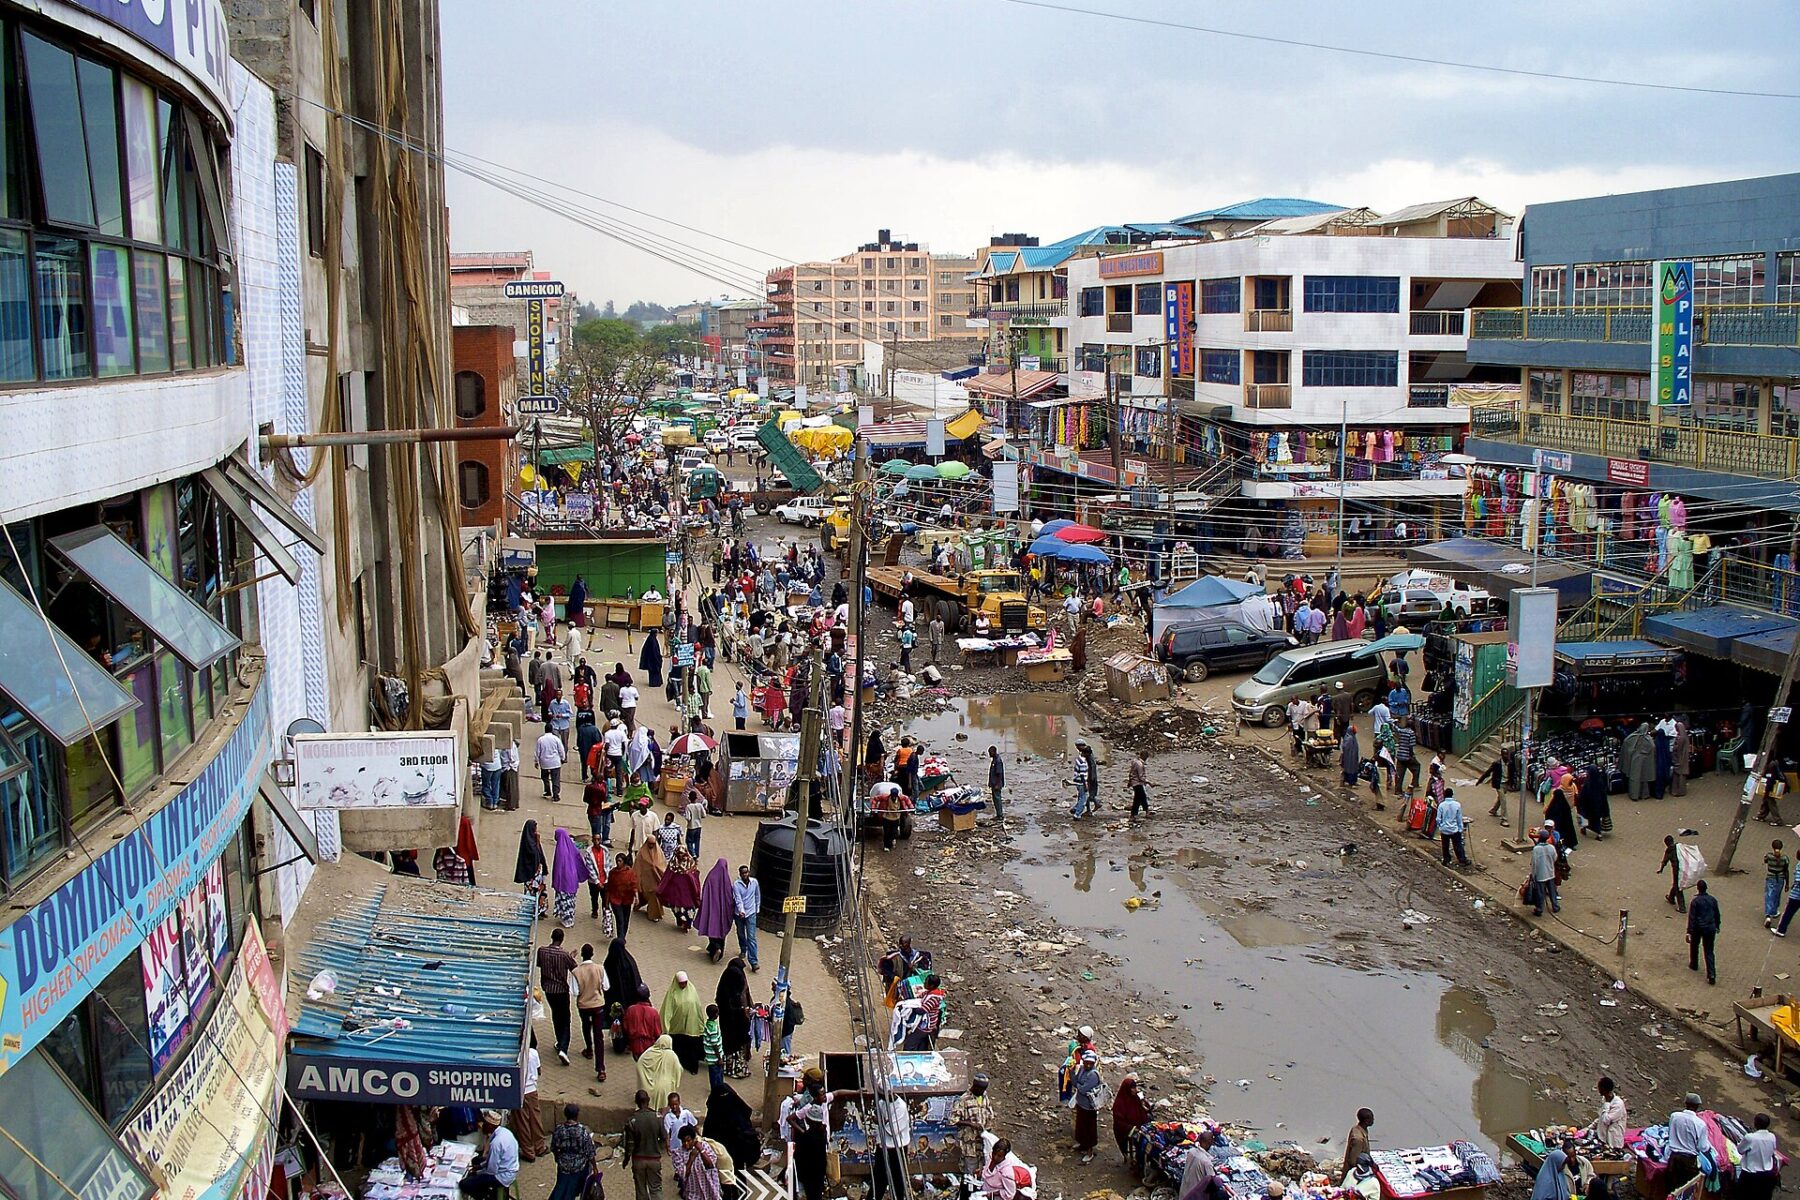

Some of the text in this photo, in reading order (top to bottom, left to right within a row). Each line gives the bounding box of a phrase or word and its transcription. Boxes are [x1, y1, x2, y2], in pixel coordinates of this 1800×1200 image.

[506, 284, 563, 296] BANGKOK
[530, 301, 543, 395] SHOPPING
[1166, 289, 1177, 369] BILAL
[1677, 301, 1689, 401] PLAZA
[520, 400, 556, 412] MALL
[400, 755, 448, 766] 3RD FLOOR
[12, 820, 157, 997] DOMINION
[147, 853, 191, 914] DIPLOMAS
[20, 965, 73, 1029] HIGHER
[74, 909, 133, 982] DIPLOMAS
[297, 1065, 512, 1098] AMCO SHOPPING
[450, 1087, 495, 1103] MALL
[161, 1133, 190, 1184] PRIMARY
